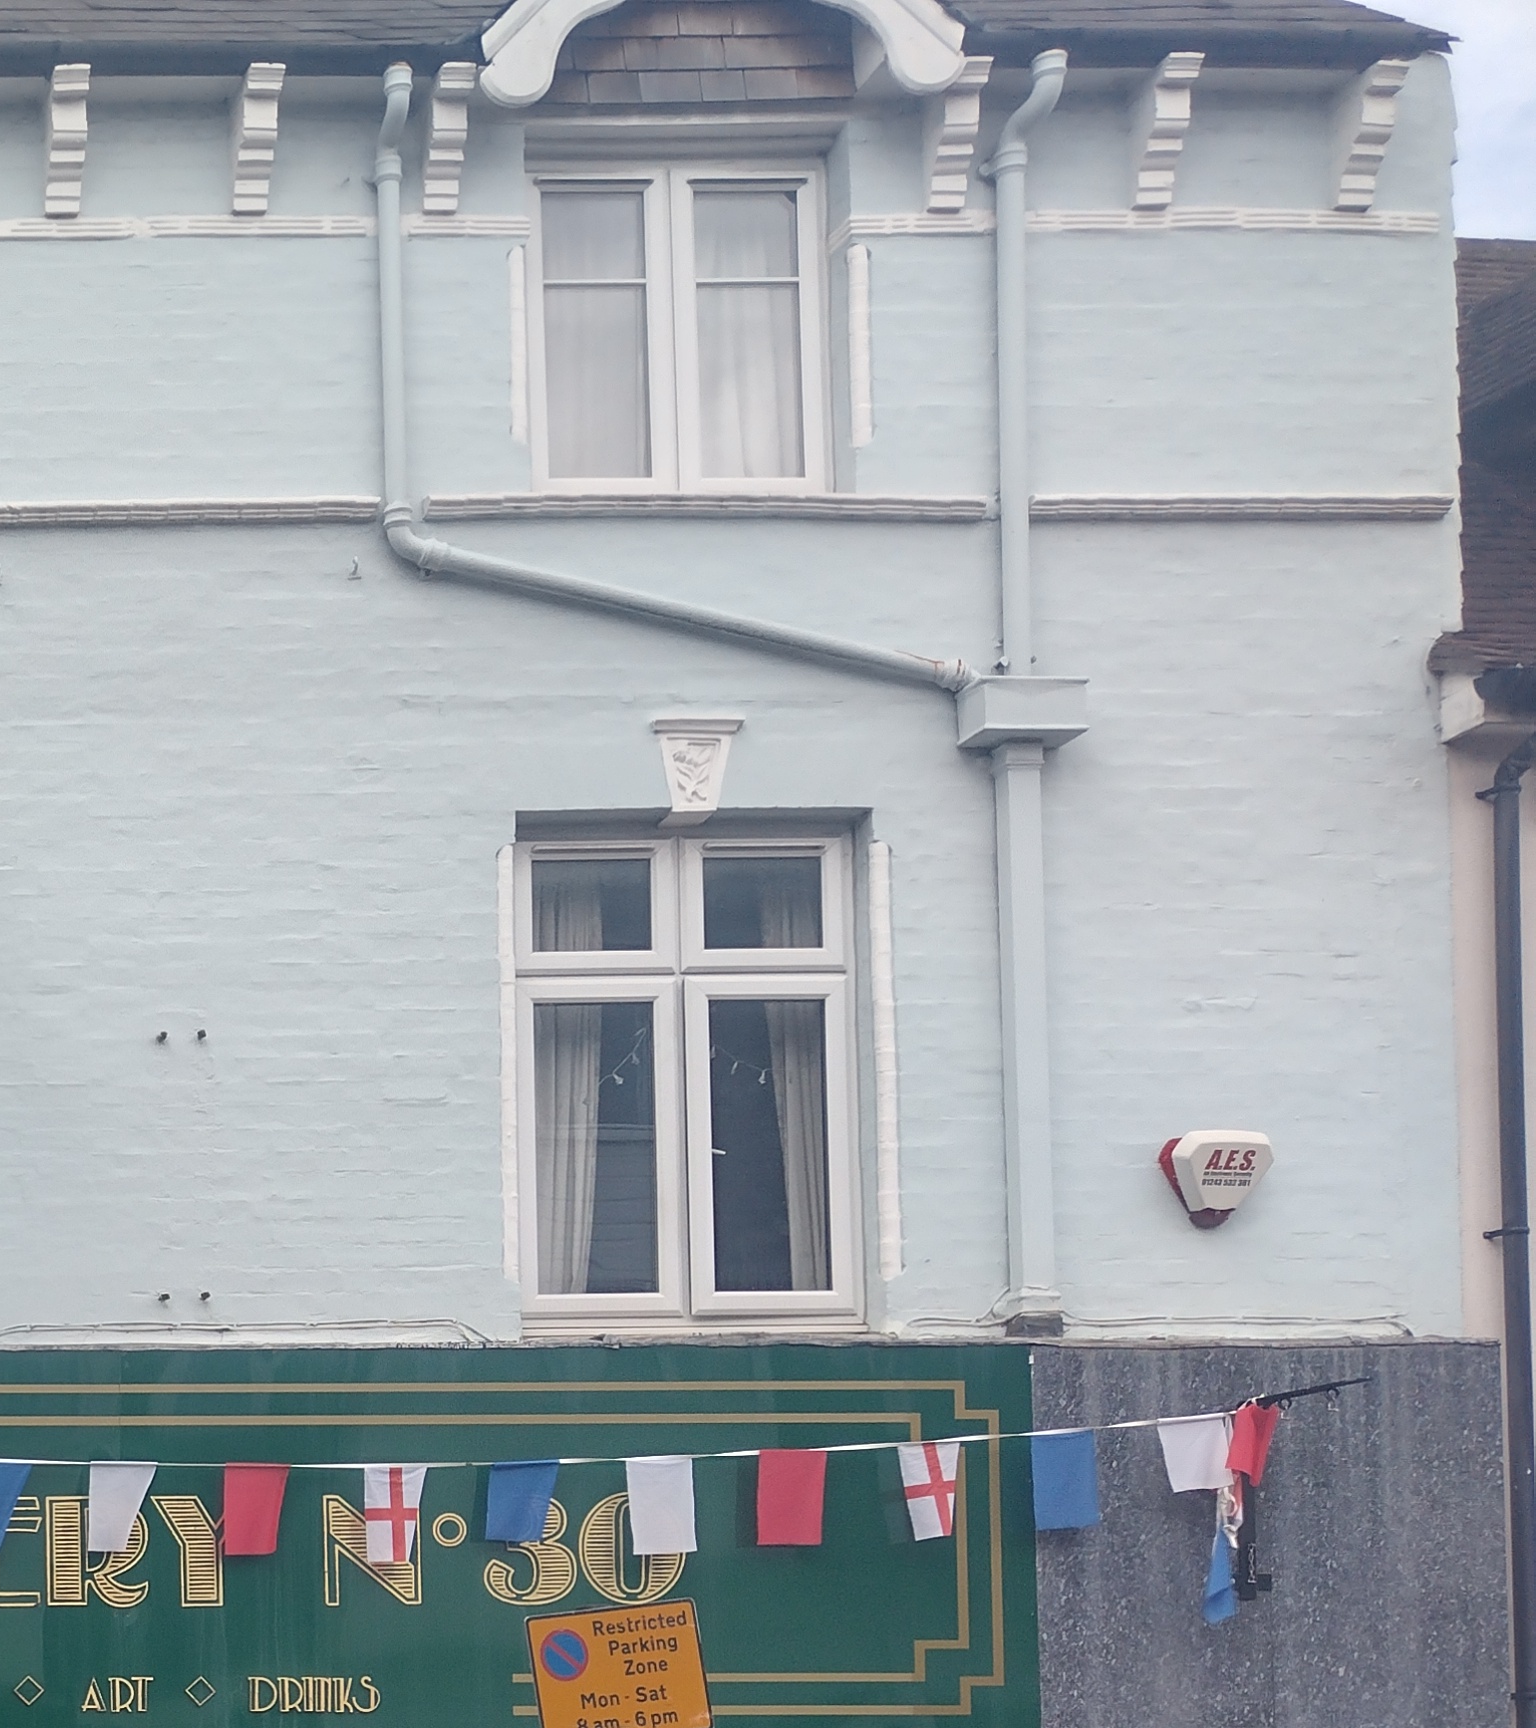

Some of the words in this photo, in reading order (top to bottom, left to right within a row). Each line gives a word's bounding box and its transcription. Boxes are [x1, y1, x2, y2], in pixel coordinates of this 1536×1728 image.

[1205, 1149, 1256, 1171] A.E.S.
[592, 1610, 687, 1637] Restricted
[608, 1636, 678, 1656] Parking
[624, 1659, 668, 1676] Zone
[81, 1676, 154, 1713] ART
[247, 1676, 381, 1713] DRINKS
[580, 1692, 620, 1709] Mon
[635, 1685, 668, 1703] Sat
[635, 1711, 646, 1727] 6
[651, 1710, 678, 1728] pm
